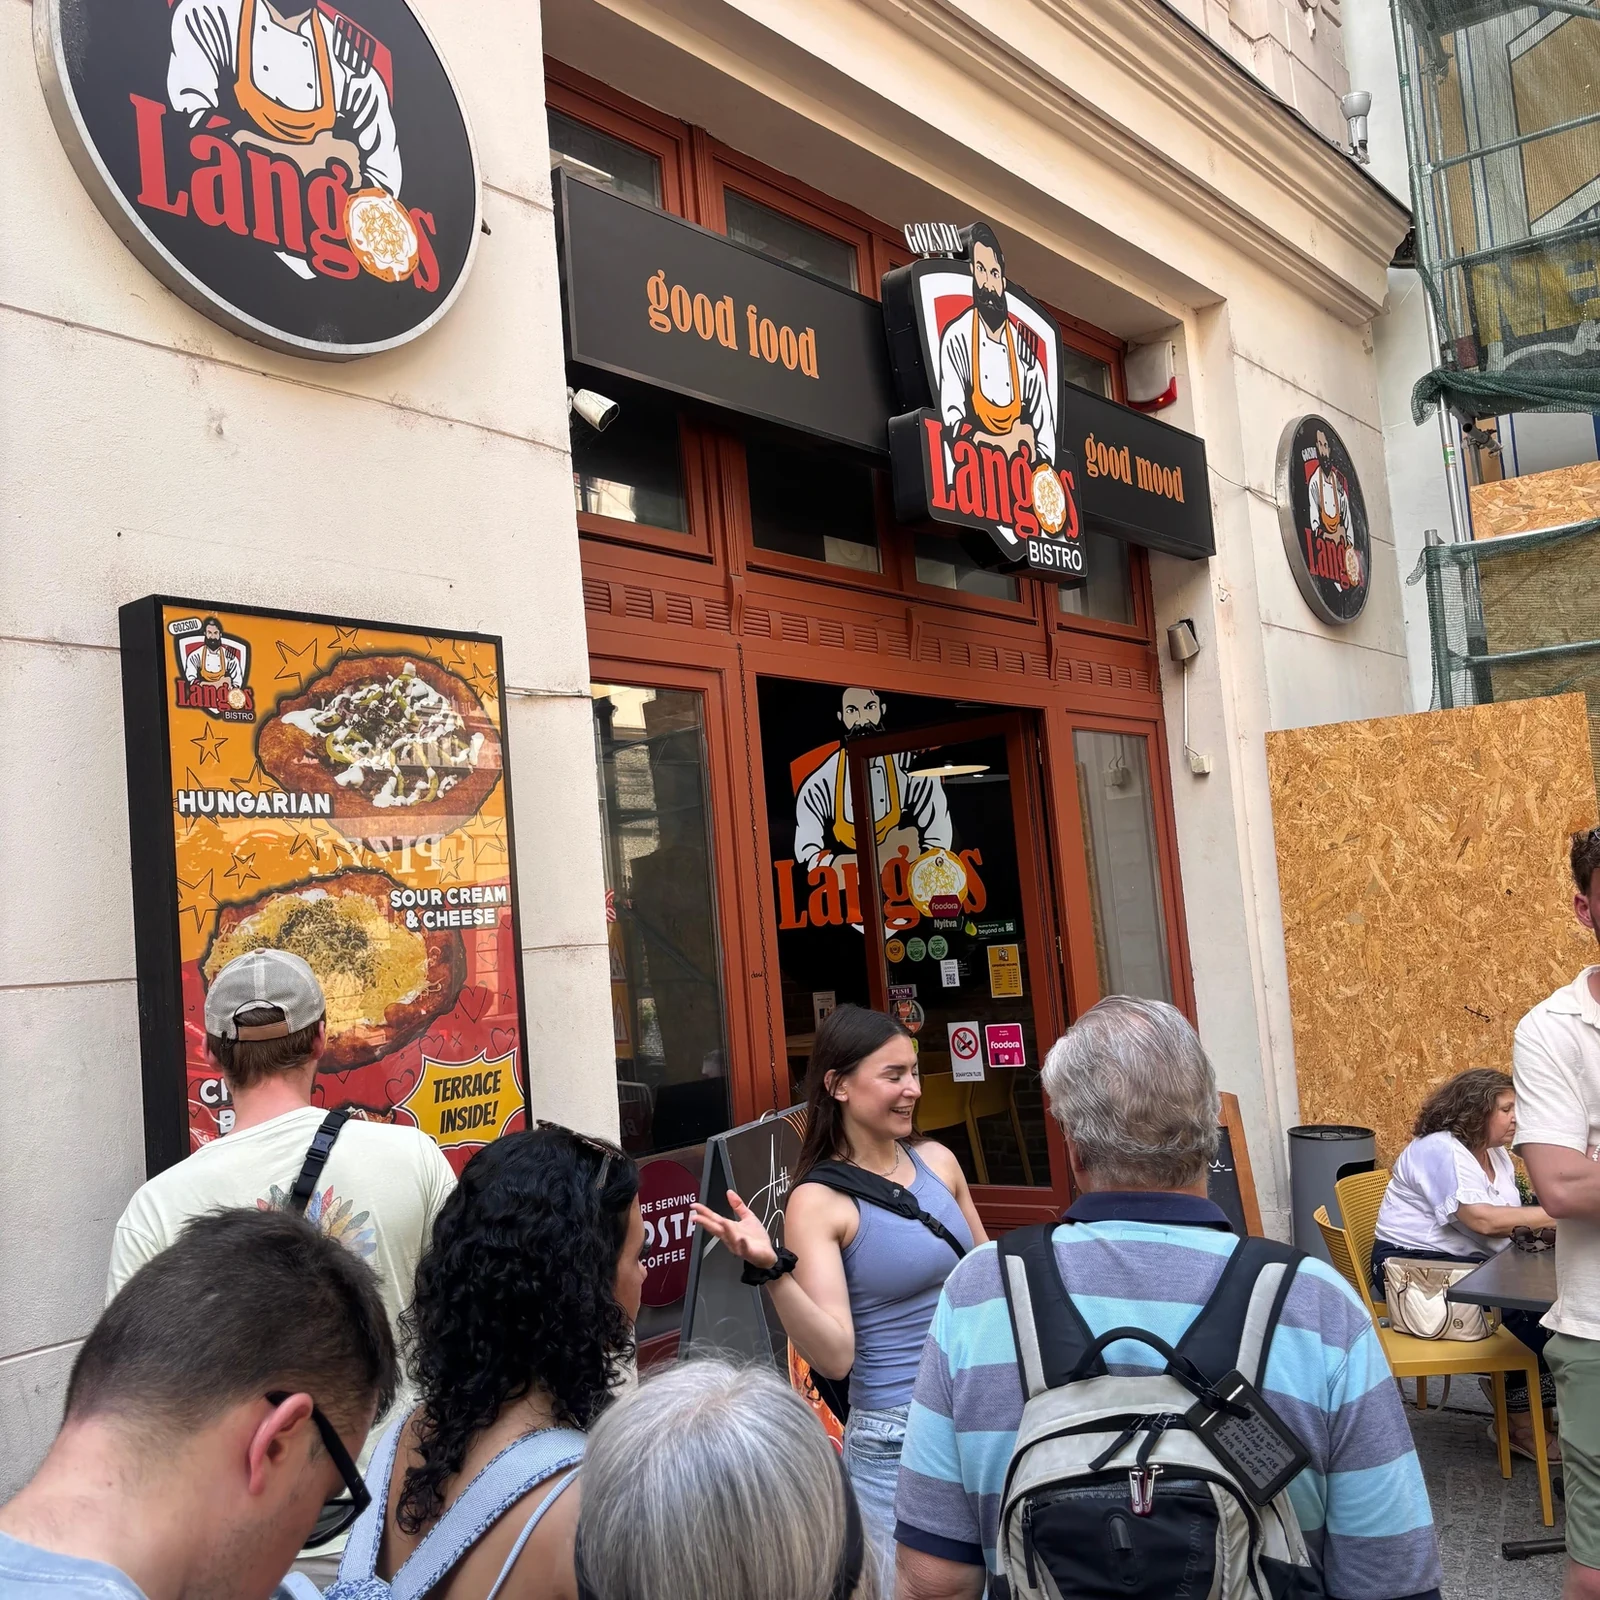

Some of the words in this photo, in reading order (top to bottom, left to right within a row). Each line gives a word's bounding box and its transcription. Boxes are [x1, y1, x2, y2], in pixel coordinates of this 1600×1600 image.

[904, 222, 963, 253] GOZSDU
[646, 269, 738, 350] good
[746, 303, 820, 379] food
[1085, 433, 1132, 485] good
[1137, 458, 1185, 503] mood
[1028, 540, 1083, 572] BISTRO
[225, 711, 254, 720] BISTRO
[178, 790, 331, 815] HUNGARIAN
[390, 888, 443, 908] SOUR
[446, 886, 507, 905] CREAM
[931, 902, 958, 910] foodora
[405, 910, 419, 928] &
[422, 908, 495, 928] CHEESE
[933, 919, 958, 930] Nyitva
[990, 1041, 1020, 1049] foodora
[433, 1070, 502, 1103] TERRACE
[440, 1100, 499, 1134] INSIDE!
[640, 1202, 653, 1214] RE
[655, 1193, 696, 1211] SERVING
[643, 1209, 698, 1248] OSTA
[1175, 1513, 1203, 1599] VICTORINO
